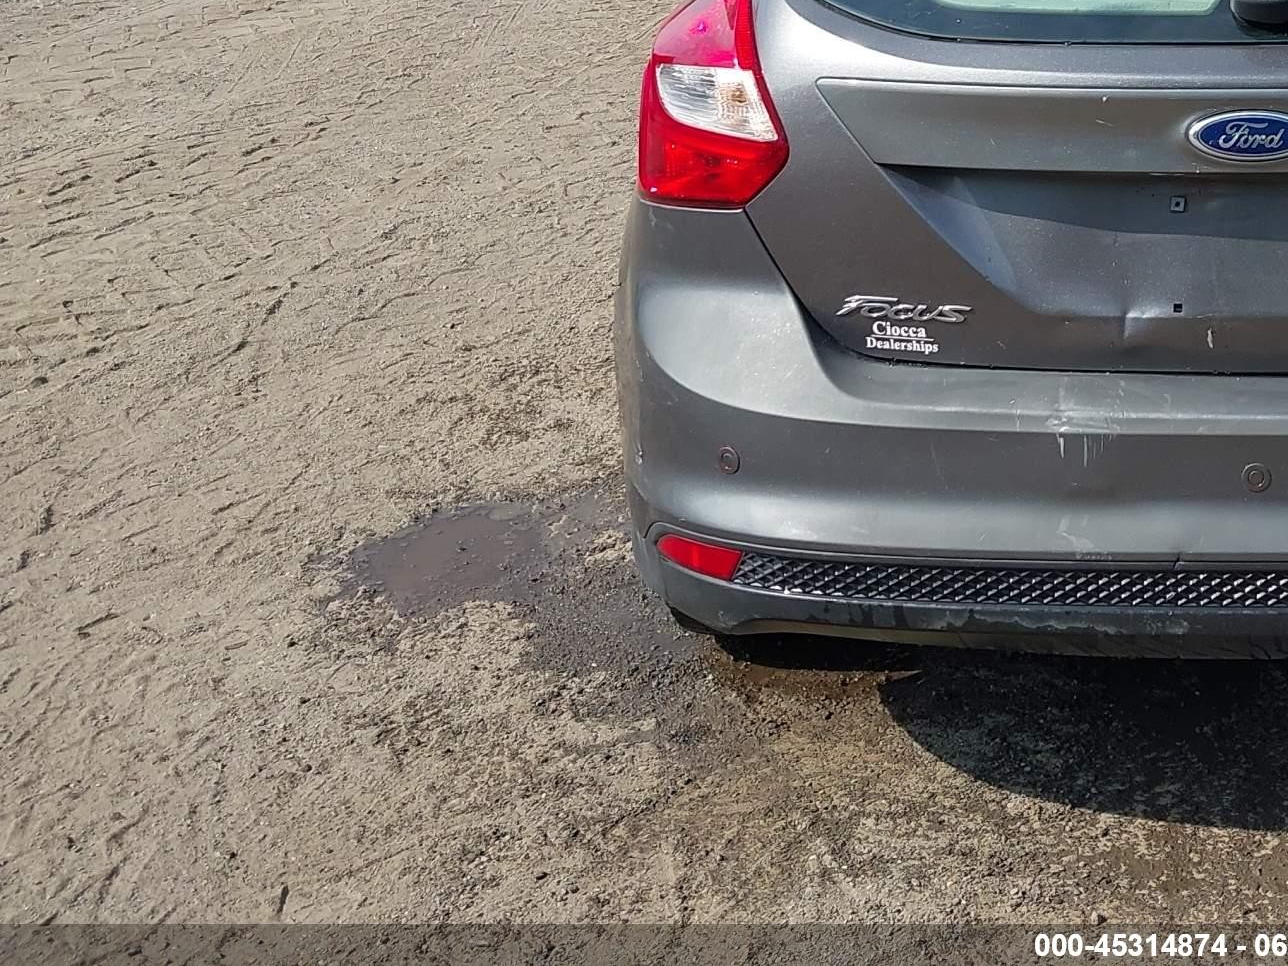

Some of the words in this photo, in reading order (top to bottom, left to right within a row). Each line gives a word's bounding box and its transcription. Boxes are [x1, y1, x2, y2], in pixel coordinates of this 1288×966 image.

[1218, 121, 1285, 149] Ford
[872, 321, 927, 338] Ciocca
[866, 337, 939, 355] Dealerships
